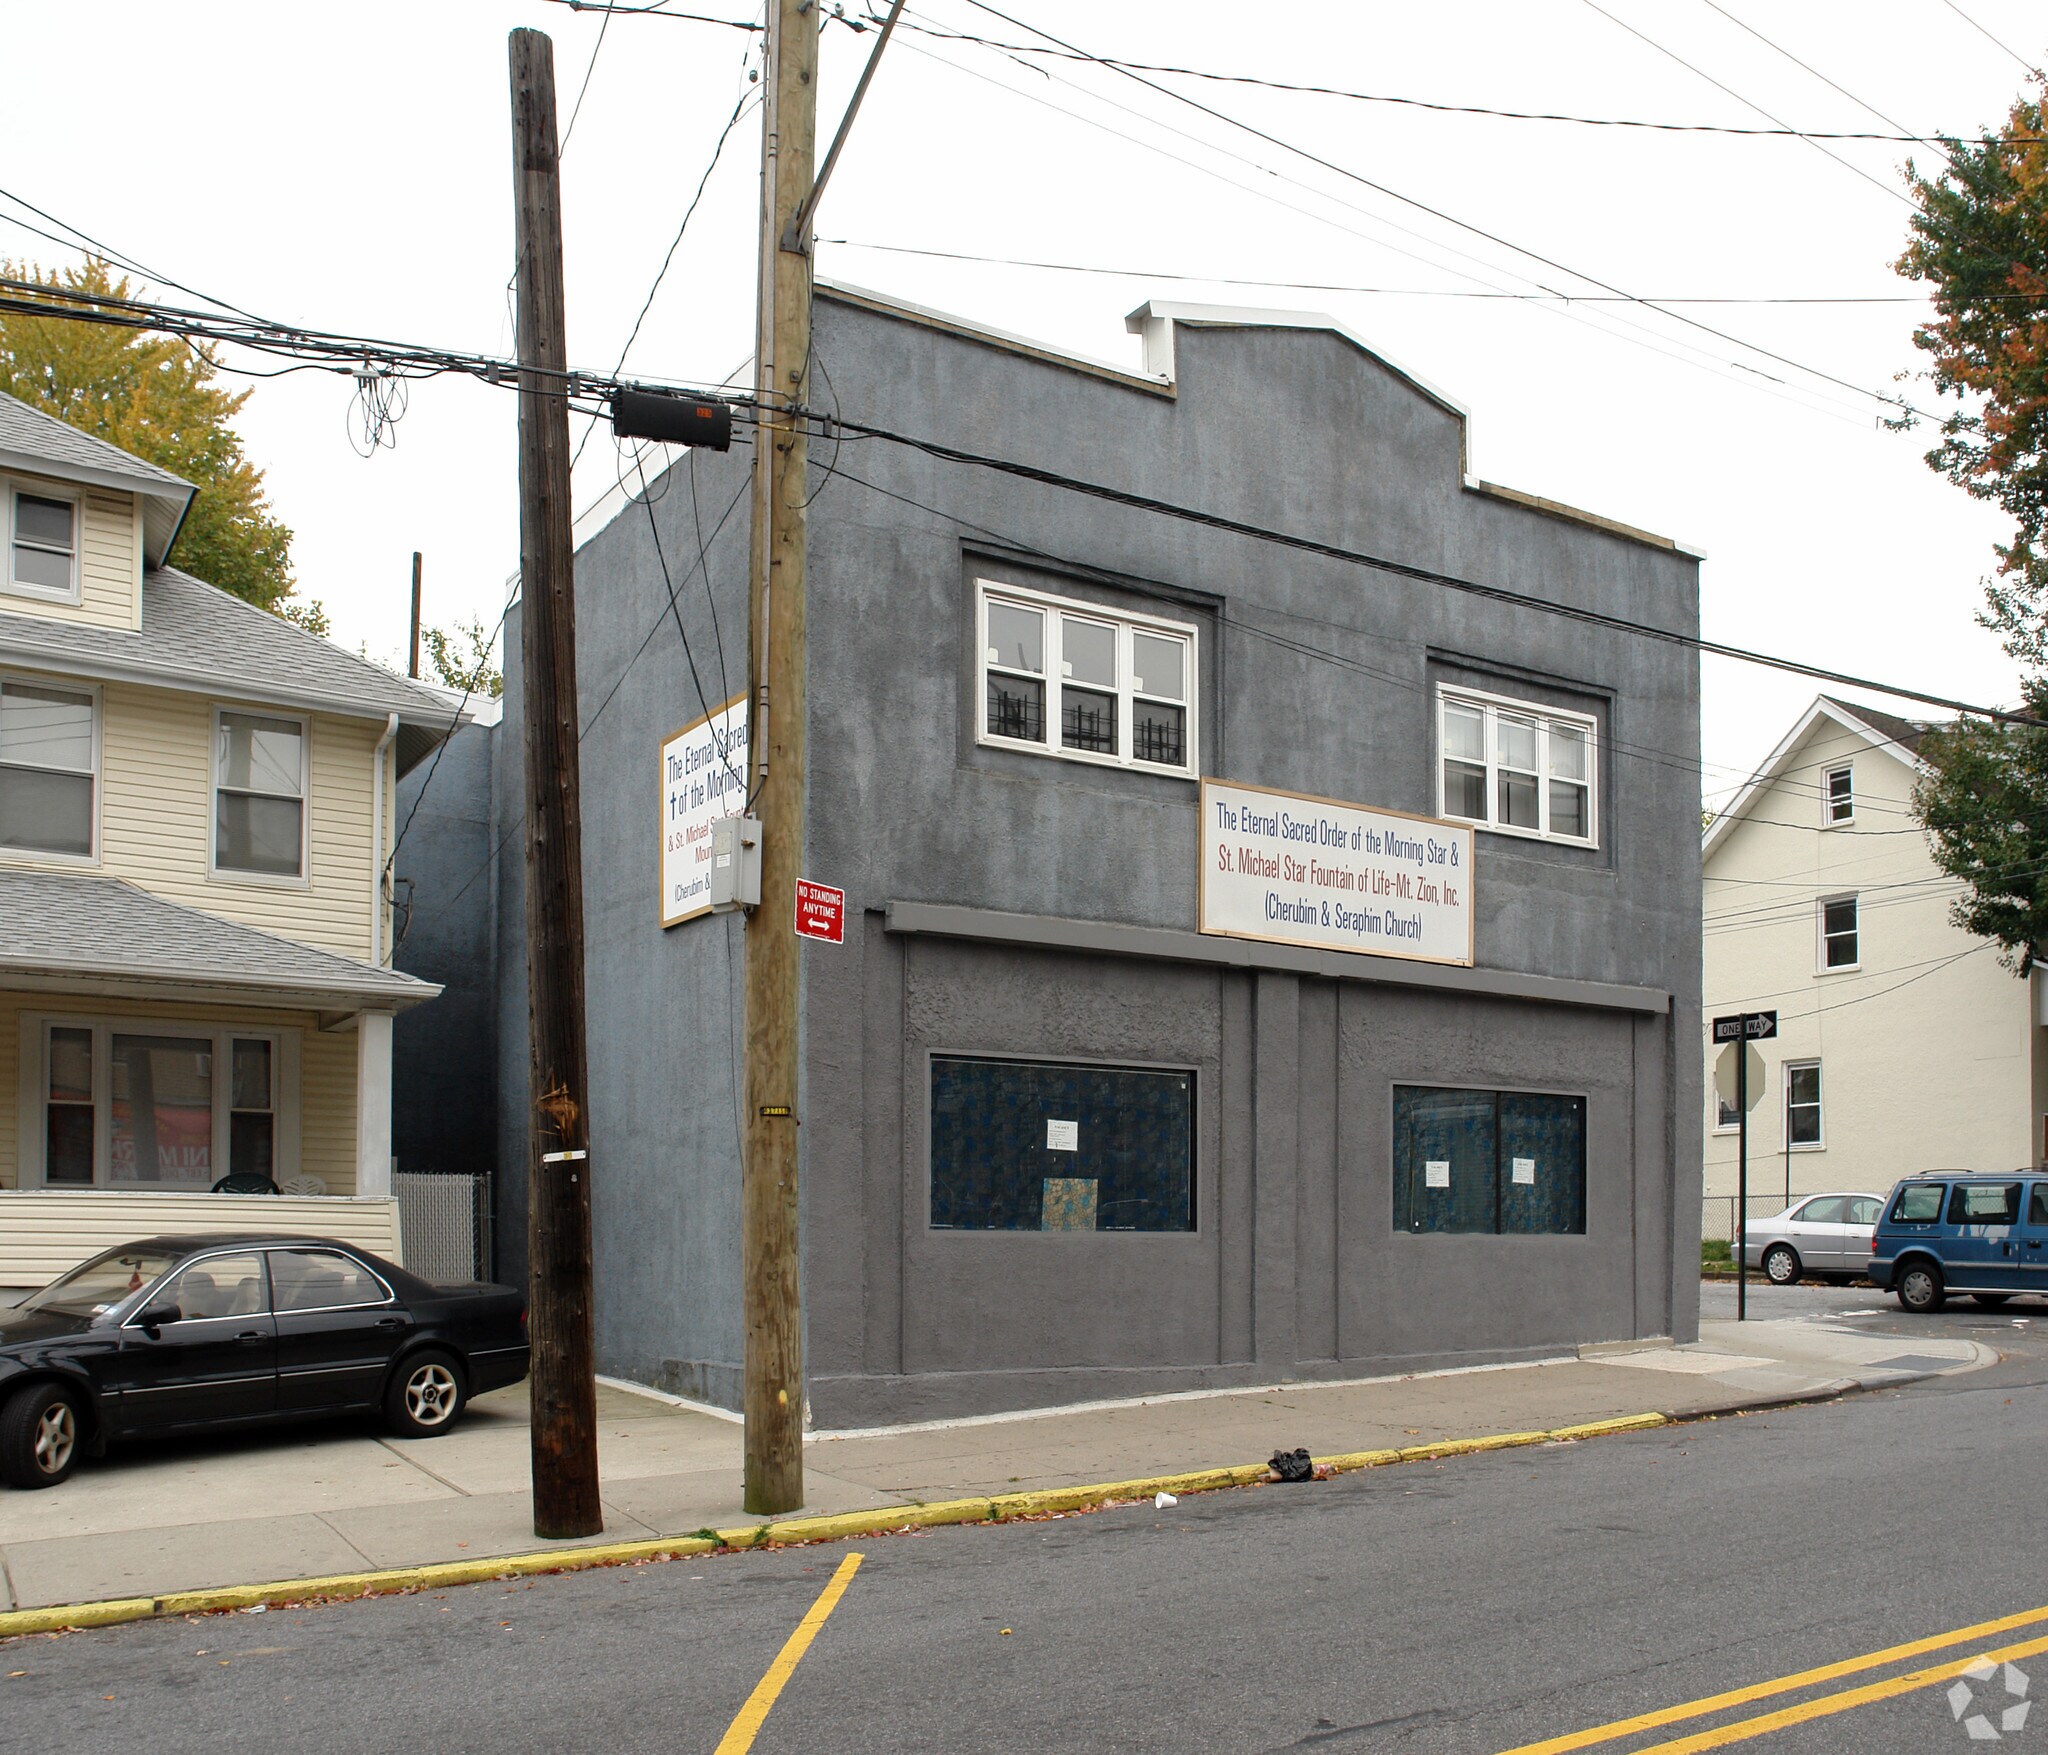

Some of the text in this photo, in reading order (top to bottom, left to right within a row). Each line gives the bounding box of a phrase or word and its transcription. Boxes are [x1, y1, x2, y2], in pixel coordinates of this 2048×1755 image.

[668, 754, 682, 784] The
[686, 734, 715, 775] Eternal
[679, 761, 743, 815] of the Morning
[668, 835, 674, 853] &
[675, 832, 685, 849] St.
[685, 819, 709, 846] Michael
[1216, 802, 1459, 867] The Eternal Sacred Order of the Morning Star &
[675, 877, 704, 904] (Cherubim
[798, 885, 841, 906] NO STANDING
[1218, 844, 1234, 872] St.
[1238, 847, 1280, 879] Michael
[1284, 854, 1307, 883] Star
[1311, 859, 1354, 891] Fountain
[1357, 867, 1369, 893] of
[1417, 875, 1440, 907] Zion,
[1443, 879, 1460, 907] Inc.
[802, 901, 836, 919] ANYTIME
[1265, 889, 1422, 942] (Cherubim & Seraphim Church)
[1722, 1020, 1767, 1035] ONE WAY
